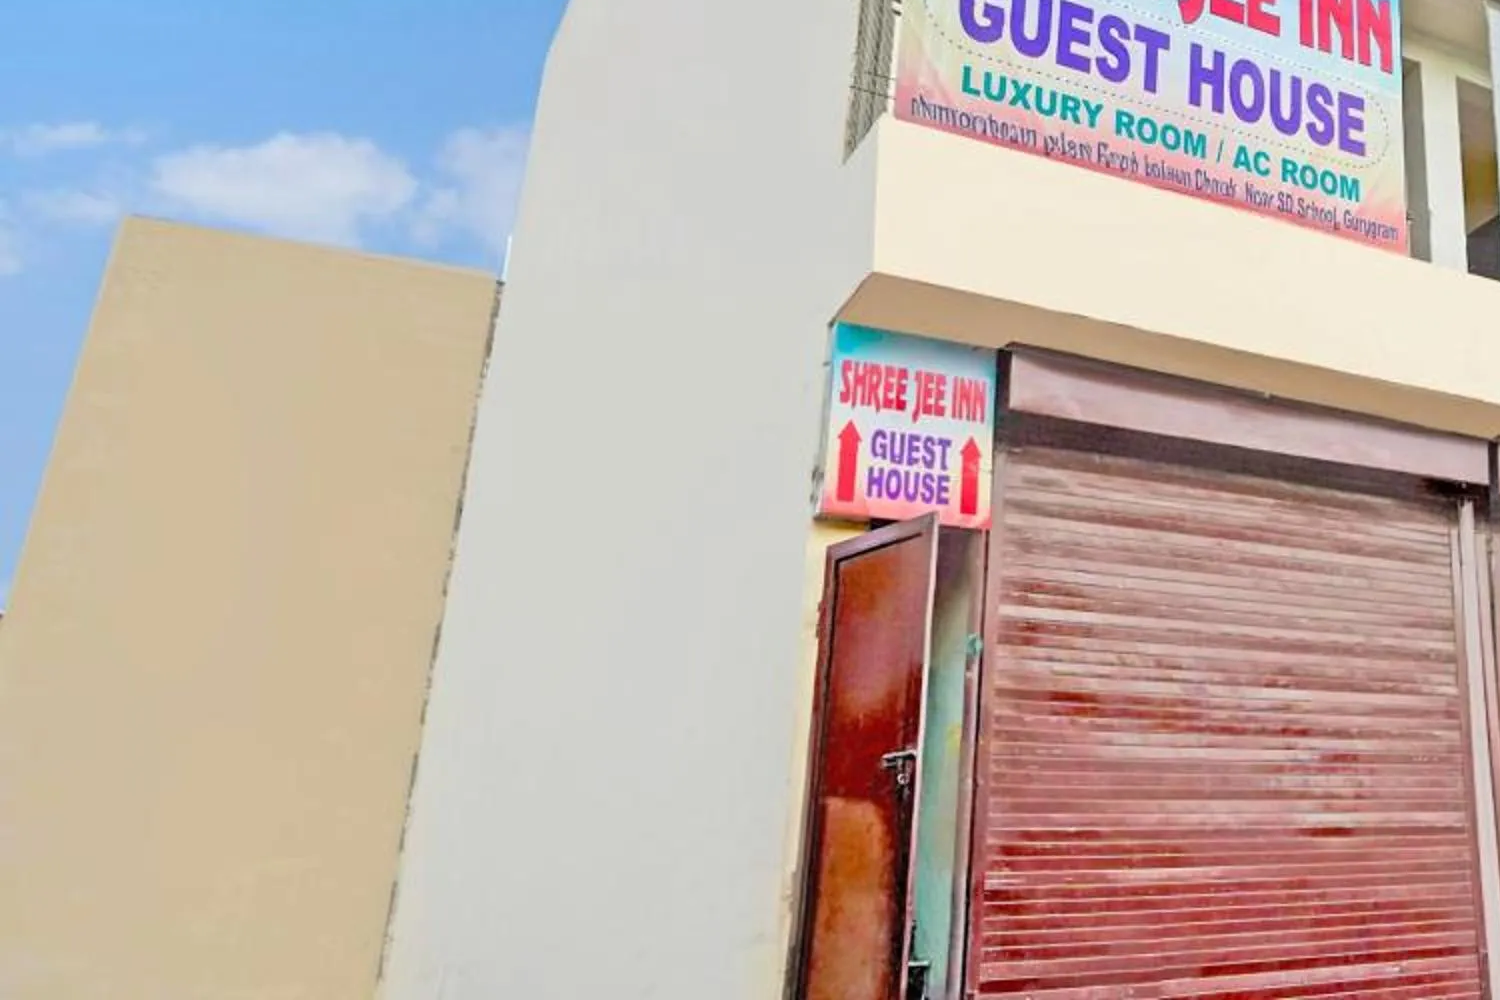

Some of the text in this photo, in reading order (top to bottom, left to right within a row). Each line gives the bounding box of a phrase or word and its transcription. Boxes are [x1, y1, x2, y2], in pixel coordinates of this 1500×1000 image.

[1188, 43, 1367, 158] HOUSE
[960, 64, 1105, 130] LUXURY
[1114, 109, 1208, 160] ROOM
[1233, 144, 1272, 178] AC
[1281, 157, 1361, 203] ROOM
[1277, 190, 1294, 214] SD
[840, 359, 986, 423] SHREE JEE INN
[871, 429, 952, 471] GUEST
[867, 467, 950, 505] HOUSE
